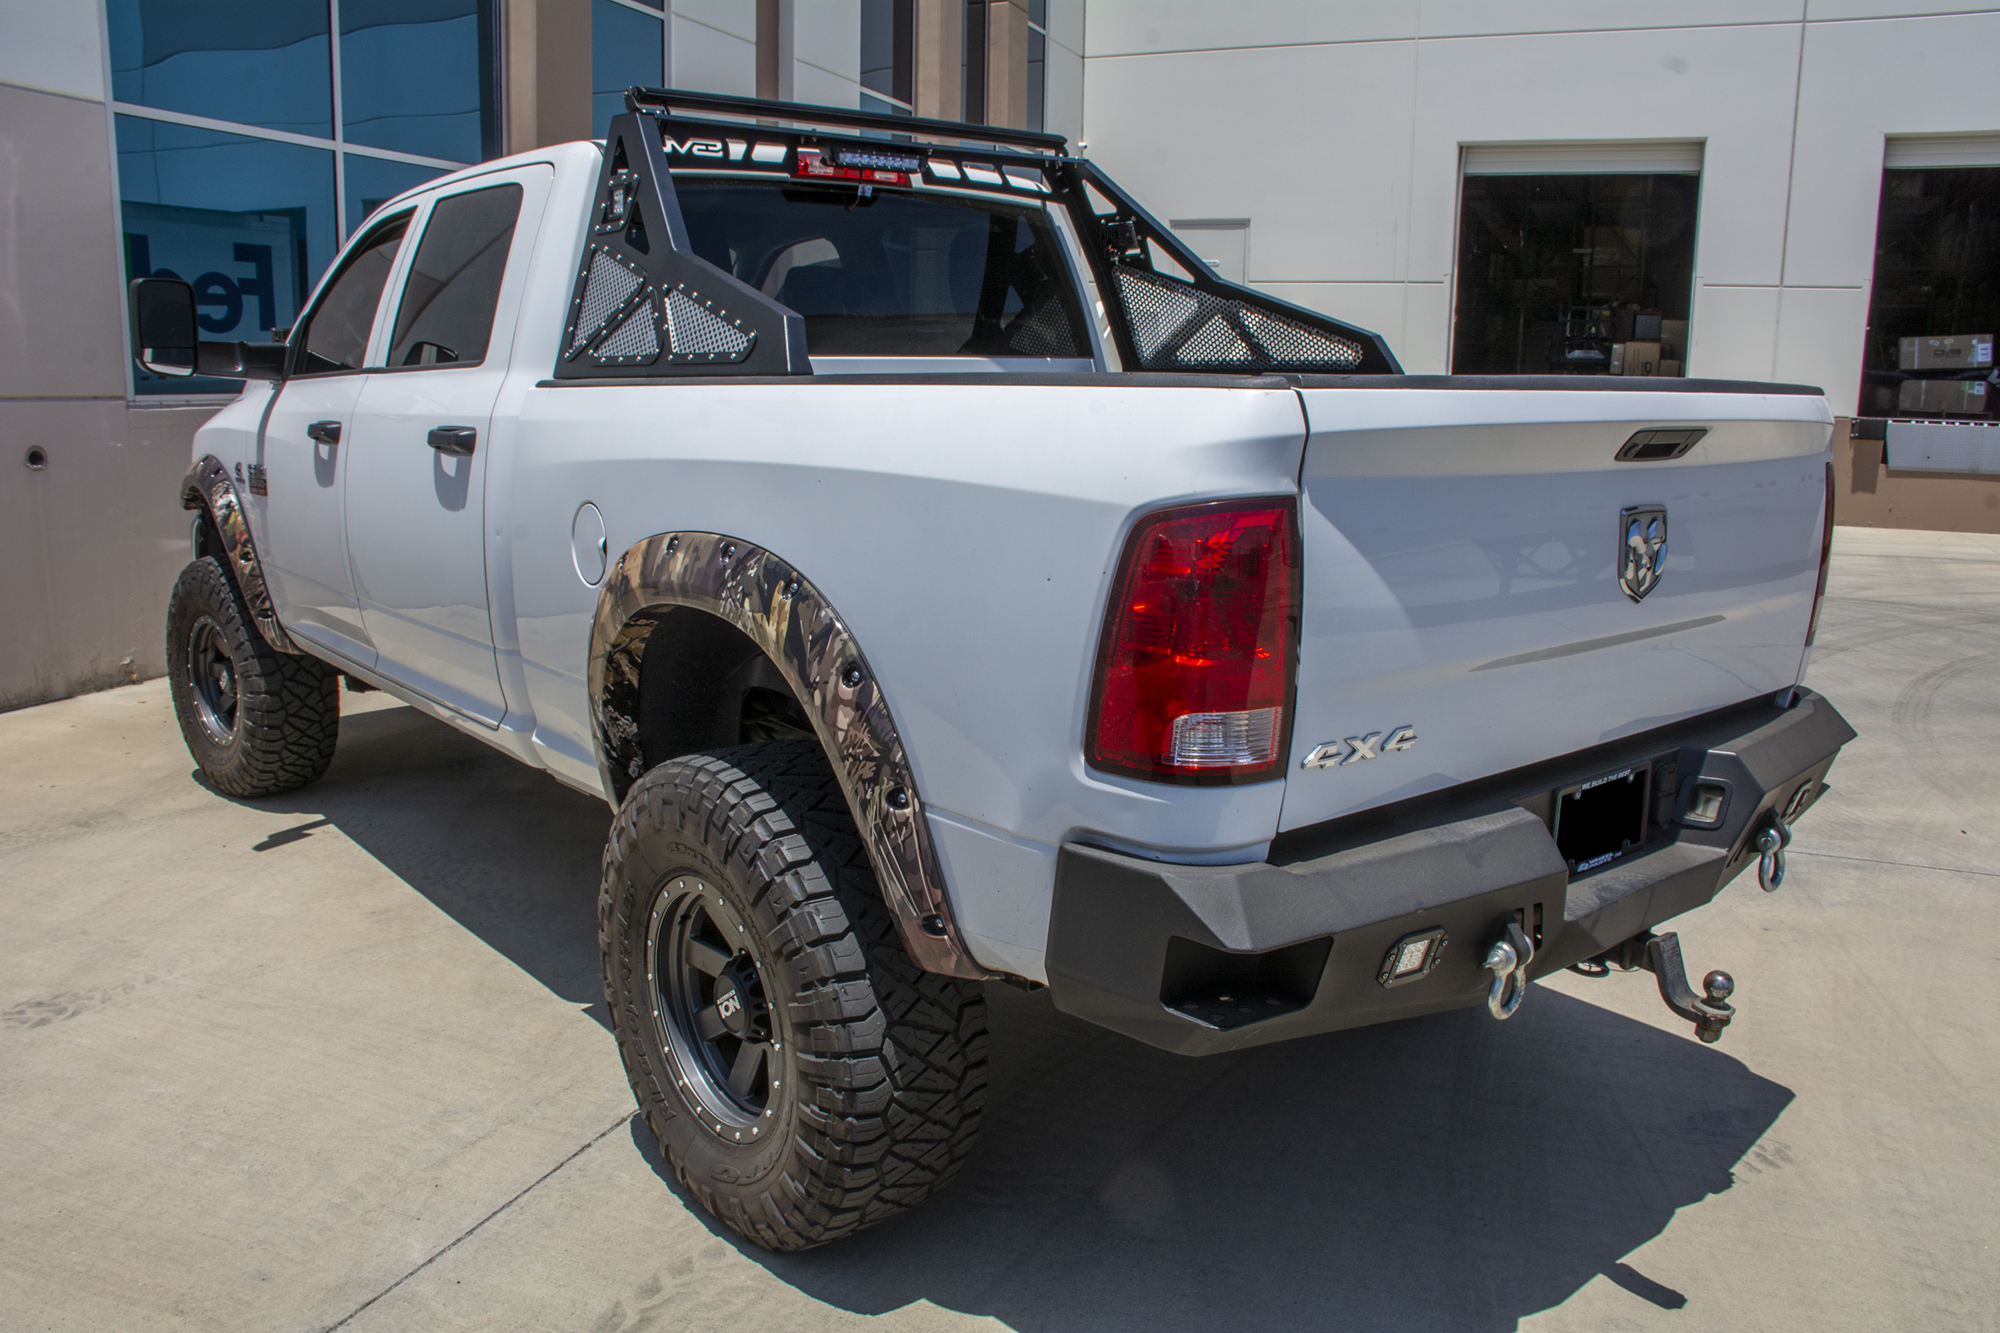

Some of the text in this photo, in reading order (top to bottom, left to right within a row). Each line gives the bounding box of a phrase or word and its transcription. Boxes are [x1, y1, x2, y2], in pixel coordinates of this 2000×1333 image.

[662, 134, 723, 158] V8
[1581, 769, 1631, 790] WE BUILD THE BEST
[718, 995, 742, 1020] ION
[632, 1036, 677, 1123] RIDGE
